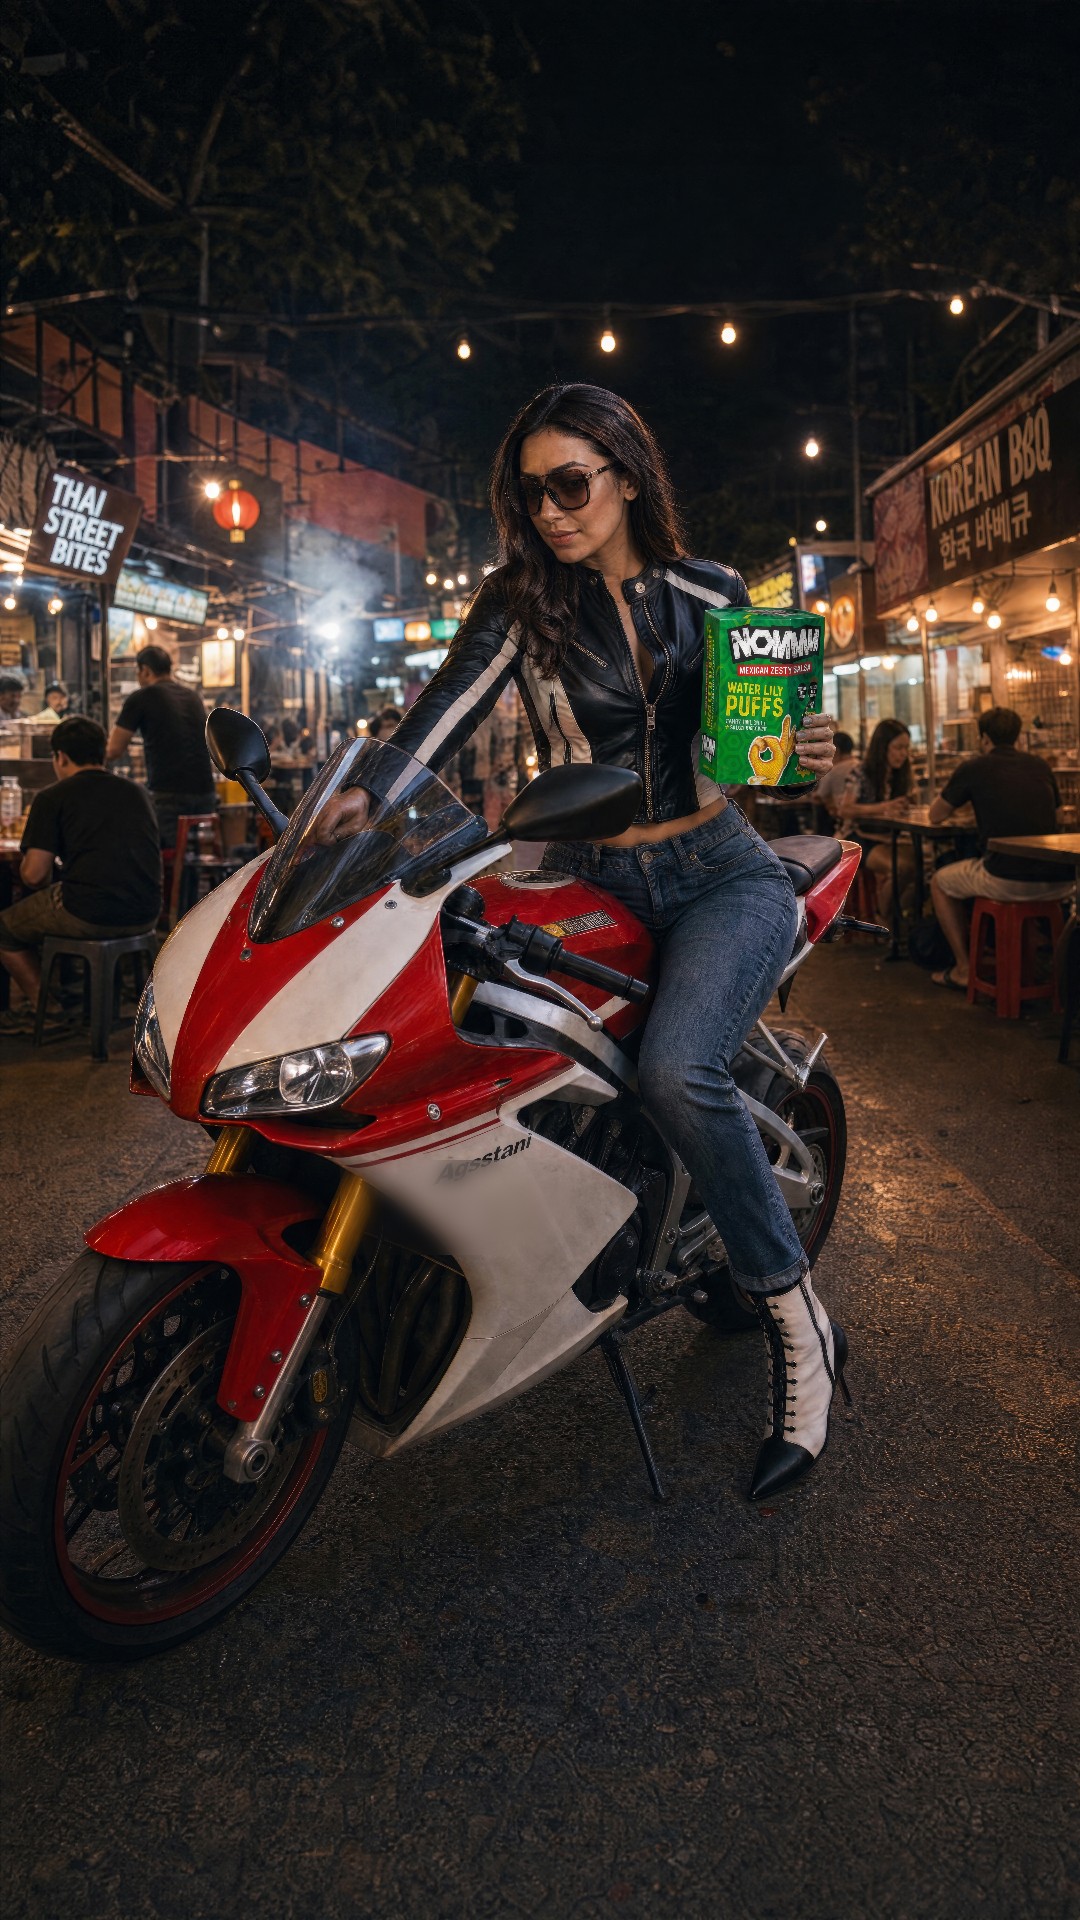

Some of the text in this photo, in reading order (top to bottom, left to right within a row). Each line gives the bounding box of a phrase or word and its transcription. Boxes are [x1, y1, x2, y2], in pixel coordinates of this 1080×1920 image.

[929, 405, 1052, 530] KOREAN BBQ
[53, 473, 108, 518] THAI
[43, 505, 125, 552] STREET
[939, 491, 1032, 571] 한국 바베큐
[50, 536, 111, 576] BITES
[727, 681, 761, 695] WATER
[763, 684, 784, 697] LILY
[739, 666, 769, 675] MEXICAN
[770, 666, 792, 675] ZESTY
[725, 694, 784, 718] PUFFS
